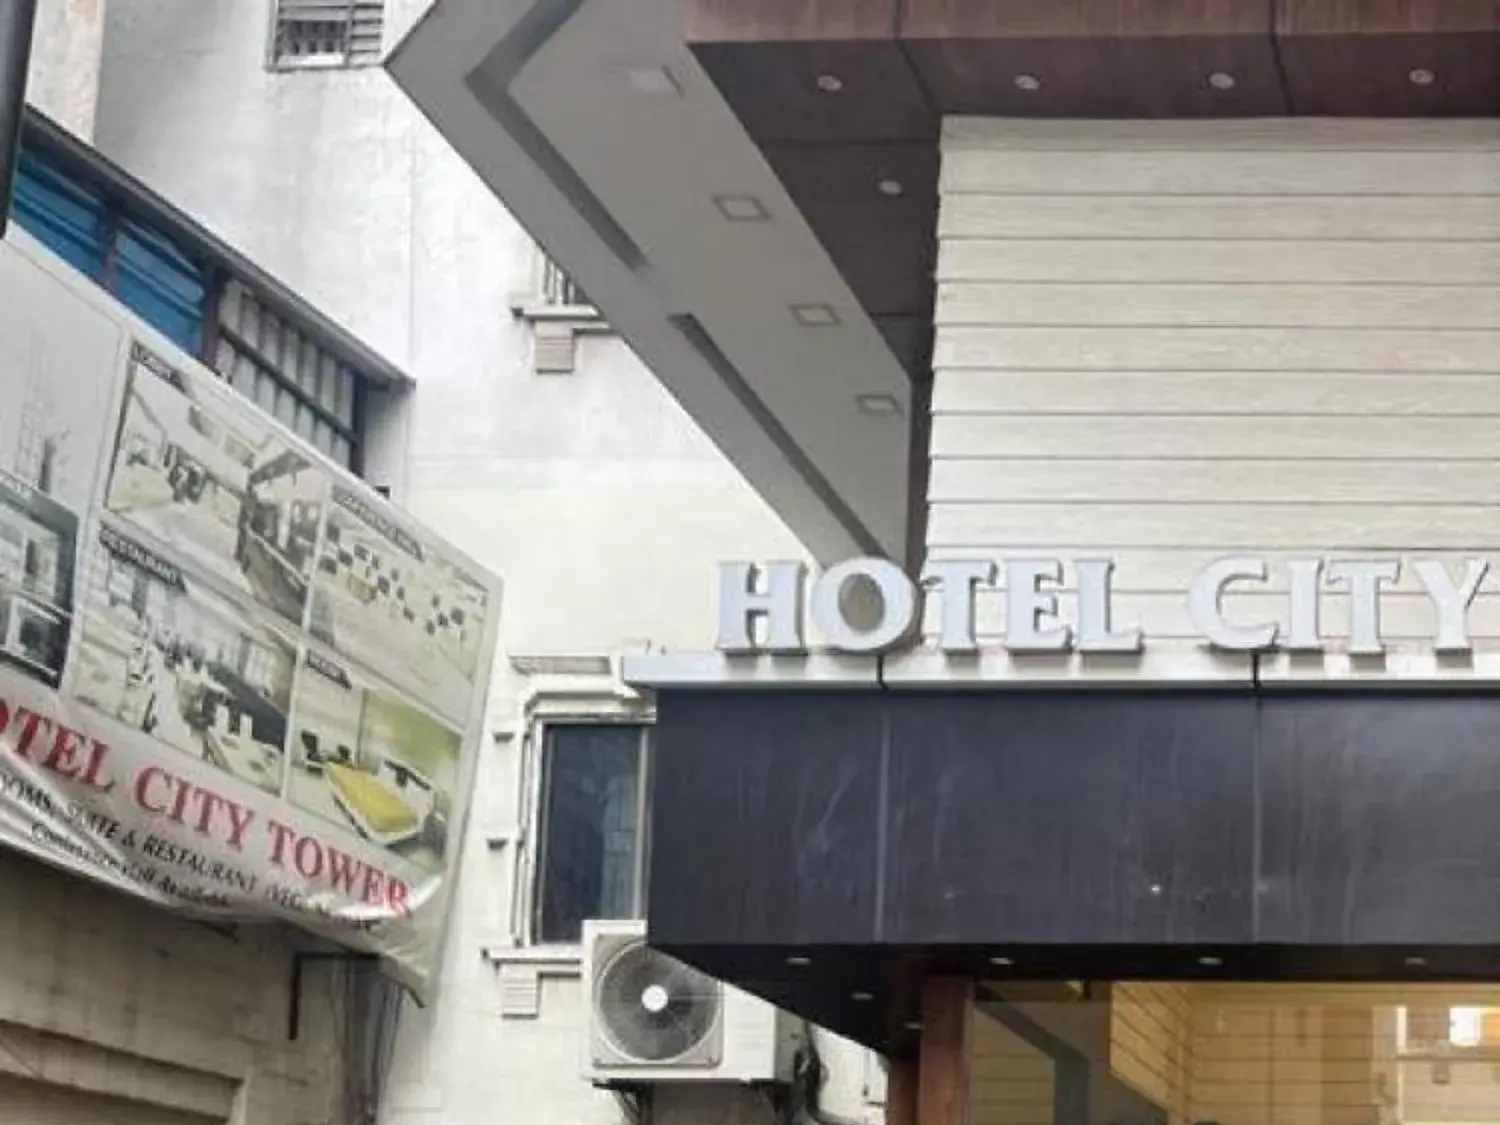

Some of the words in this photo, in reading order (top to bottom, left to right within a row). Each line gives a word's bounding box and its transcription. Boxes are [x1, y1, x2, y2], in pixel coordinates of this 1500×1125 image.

[716, 557, 1144, 653] HOTEL
[1189, 556, 1489, 654] CITY
[0, 698, 116, 794] TEL
[134, 766, 254, 850] CITY
[267, 819, 413, 919] TOWER
[122, 831, 137, 848] &
[143, 834, 259, 893] RESTAURANT
